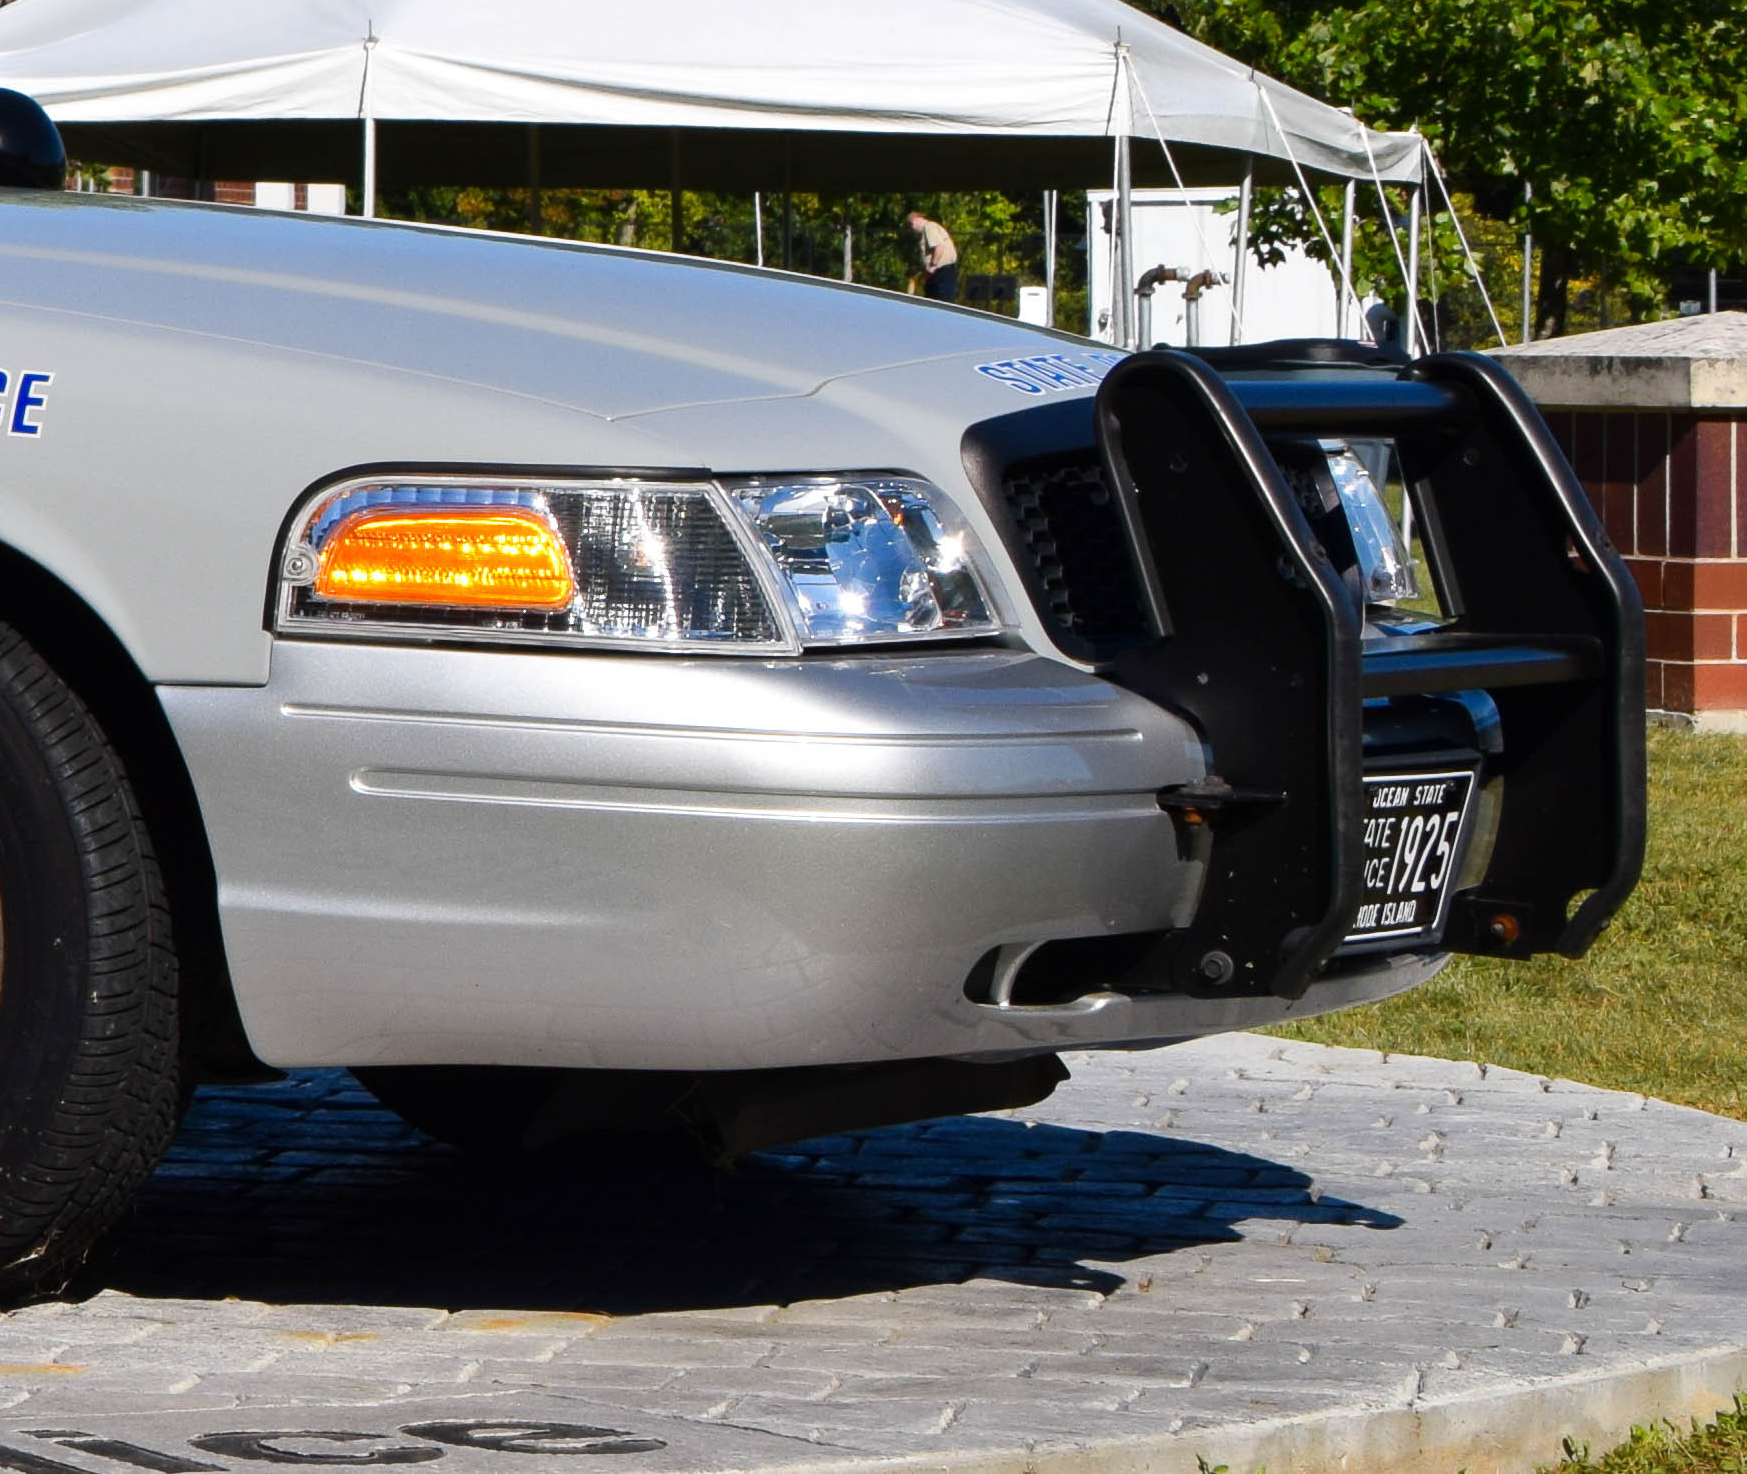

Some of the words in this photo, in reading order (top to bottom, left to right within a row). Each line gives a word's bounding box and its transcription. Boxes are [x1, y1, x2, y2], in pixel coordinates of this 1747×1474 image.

[975, 354, 1105, 395] STATE
[1414, 784, 1447, 806] STATE
[1364, 817, 1396, 848] ATE
[1387, 811, 1459, 895] 1925
[1381, 900, 1417, 926] ISLAND
